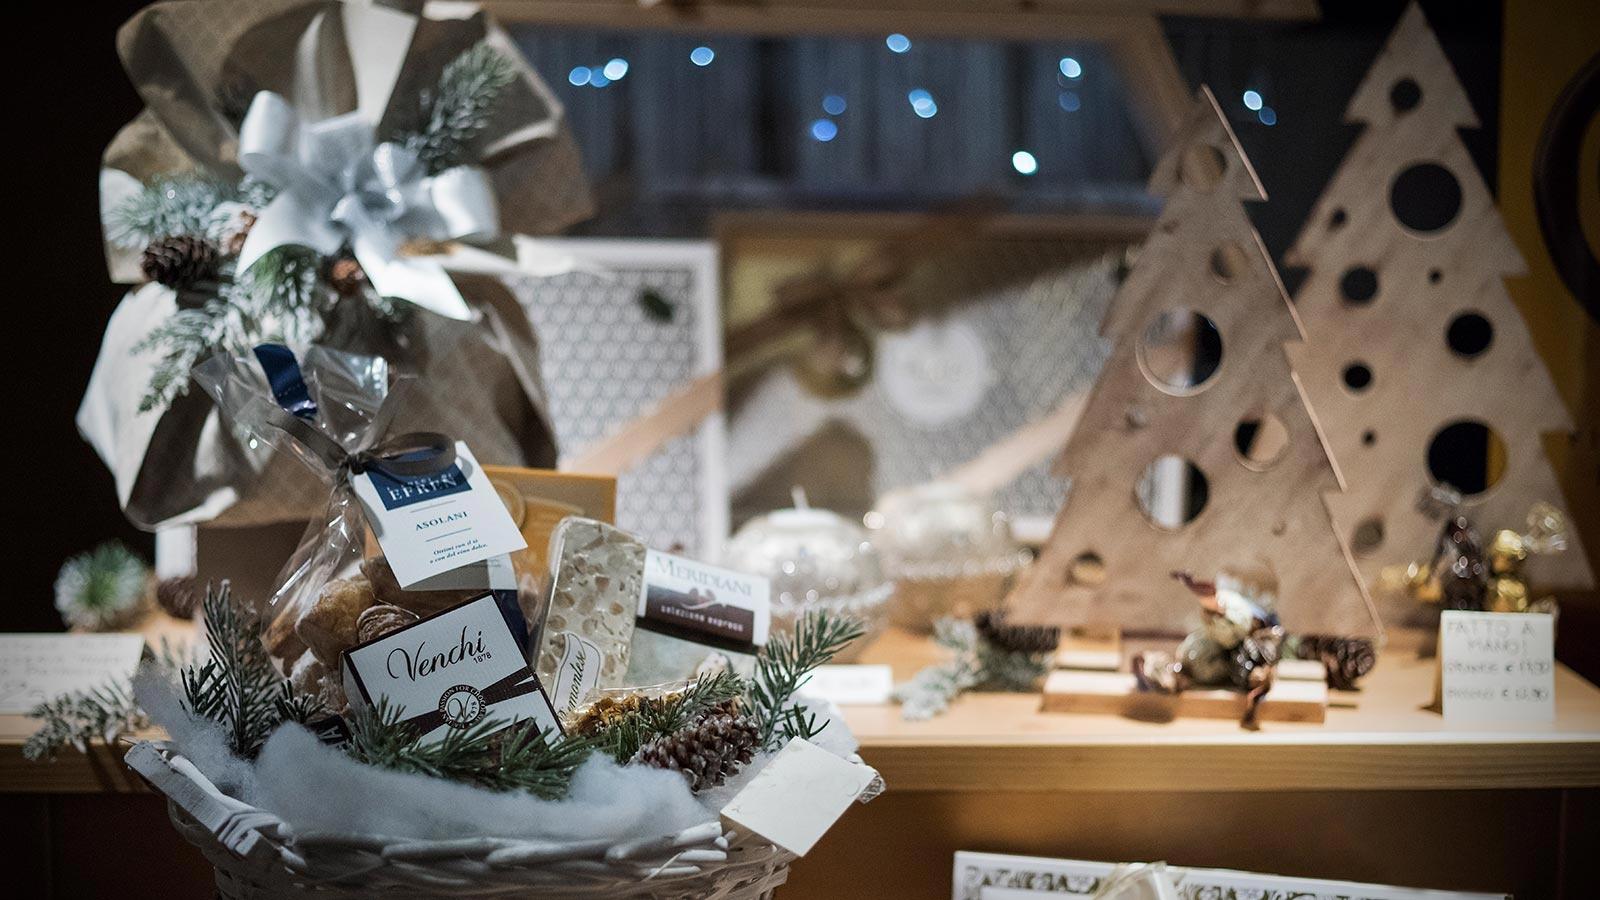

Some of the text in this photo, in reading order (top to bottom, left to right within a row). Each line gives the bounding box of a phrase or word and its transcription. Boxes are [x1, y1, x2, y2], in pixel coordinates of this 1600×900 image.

[415, 511, 468, 531] ASOLANI
[655, 556, 752, 596] MERIDIANI
[387, 625, 482, 681] Venchi
[473, 651, 492, 664] 1878
[438, 687, 455, 712] PASSION
